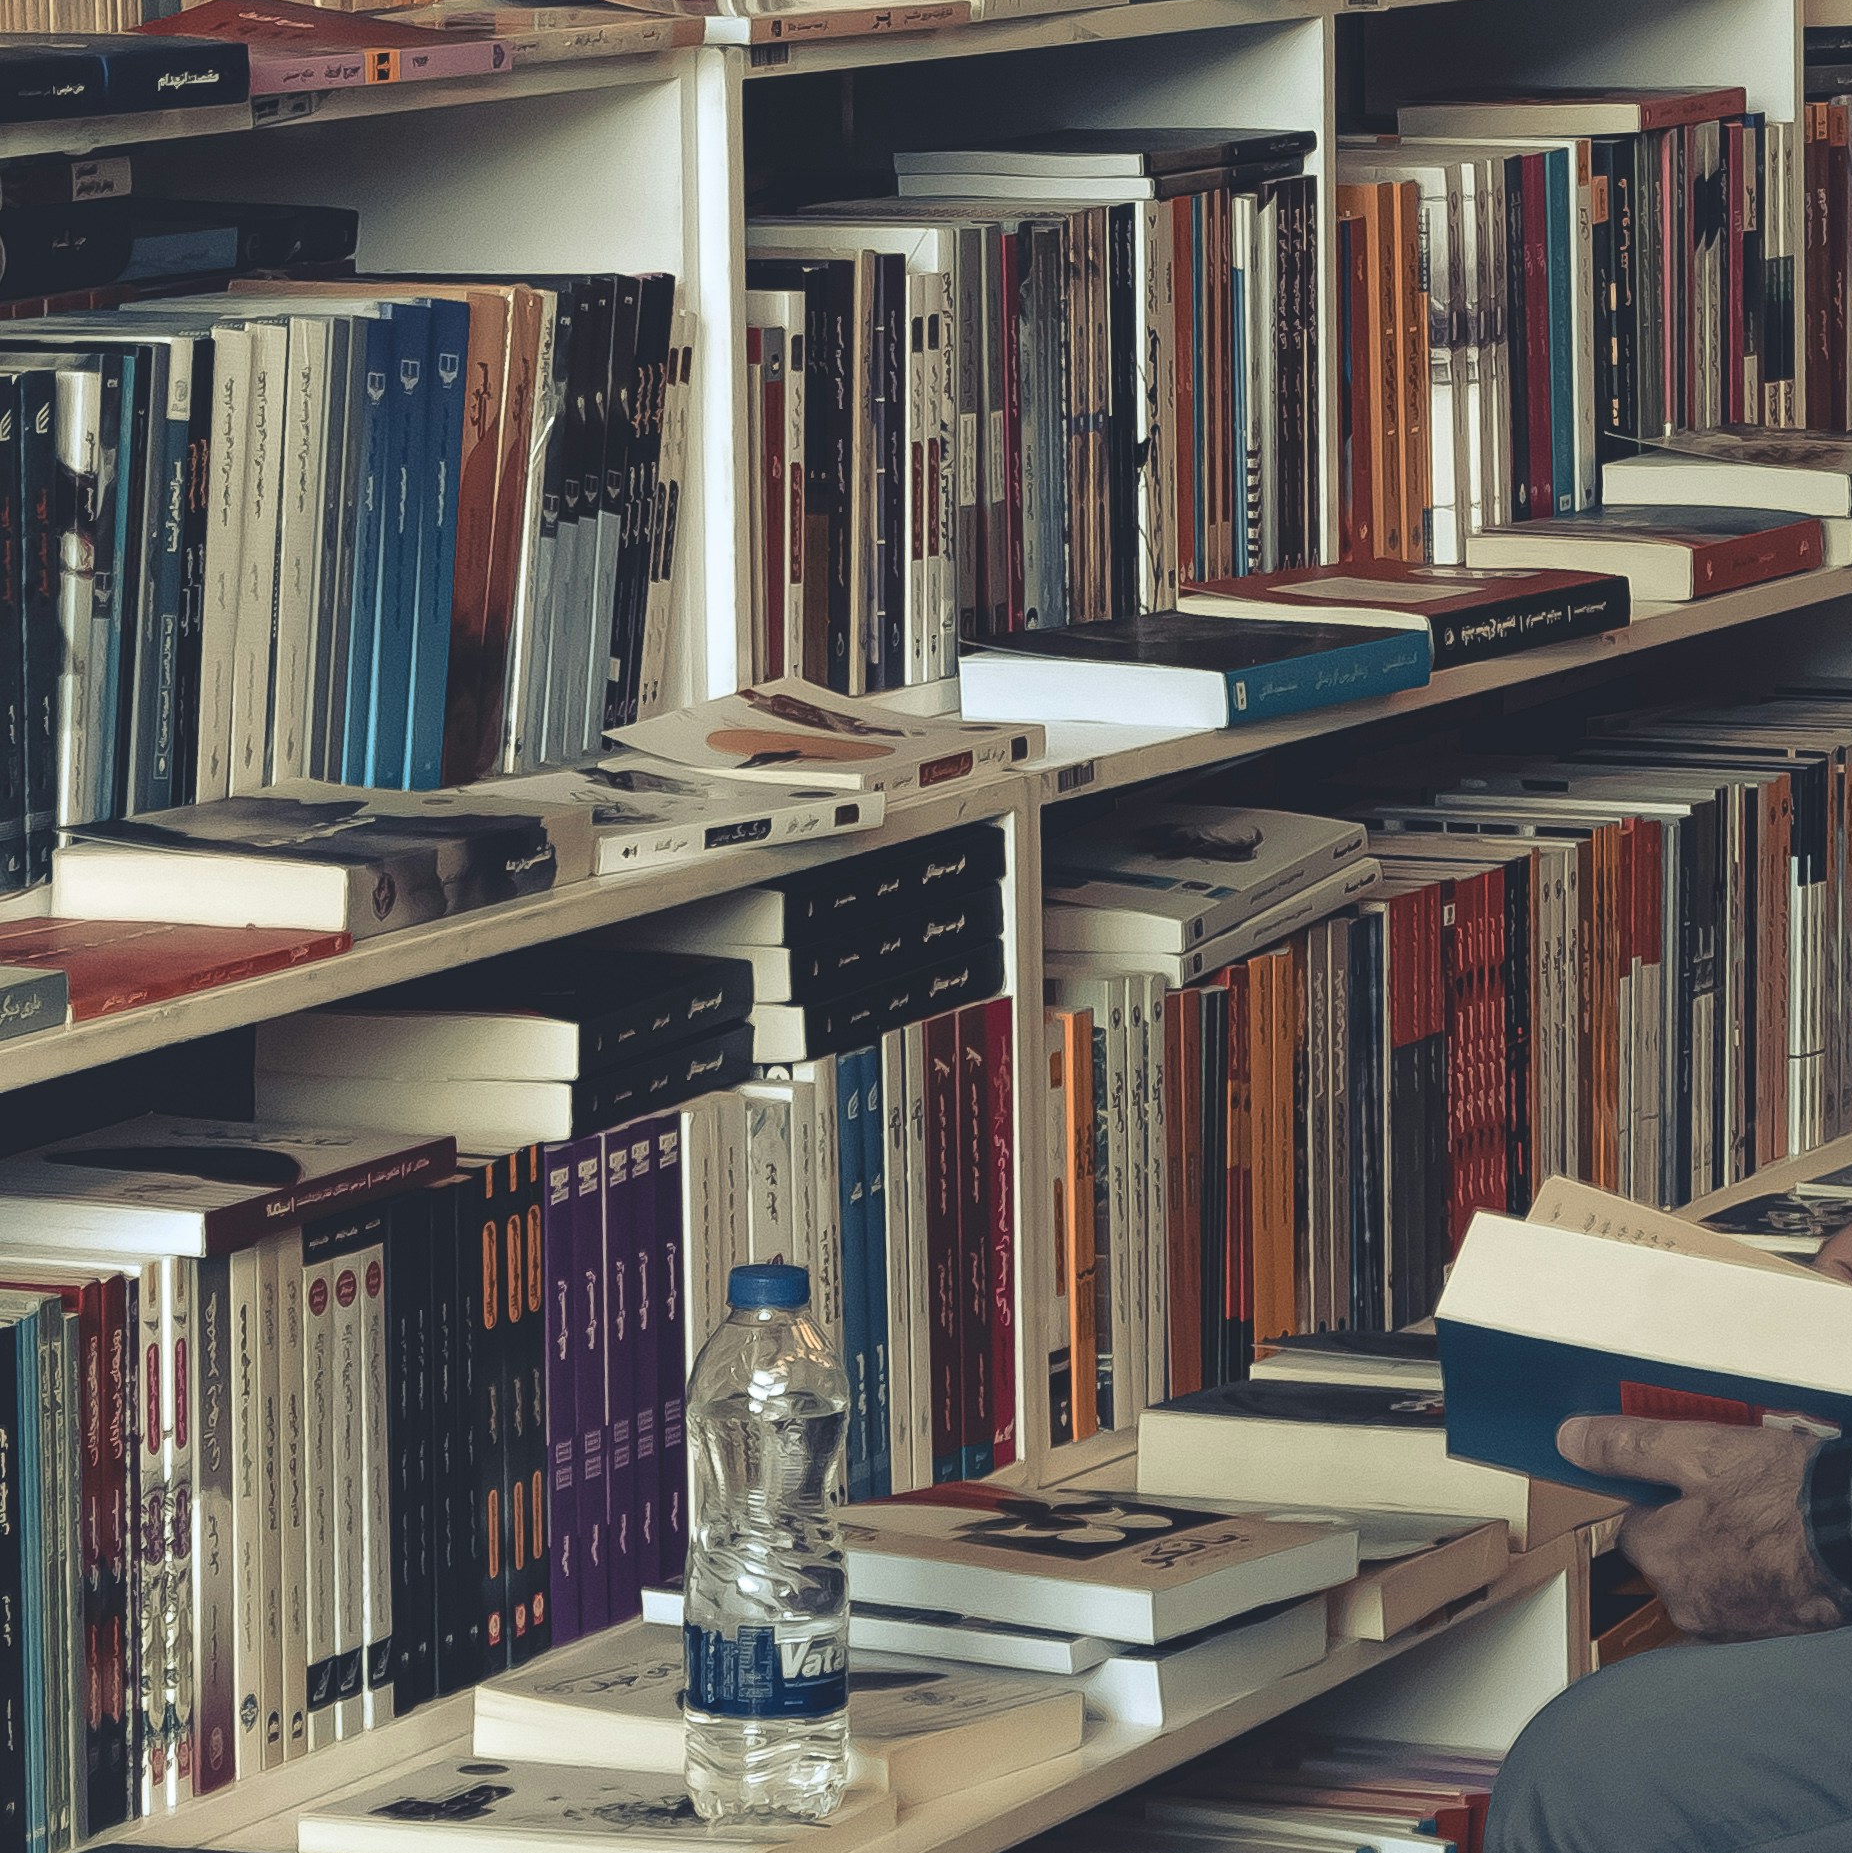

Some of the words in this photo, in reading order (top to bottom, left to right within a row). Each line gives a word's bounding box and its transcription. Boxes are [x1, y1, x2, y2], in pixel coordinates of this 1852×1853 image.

[223, 378, 235, 410] بگذار
[257, 370, 268, 404] بگذار
[300, 363, 311, 397] بگذار
[204, 1291, 219, 1377] همسر
[203, 1383, 223, 1471] پنهانی
[1137, 1530, 1254, 1571] بانکو
